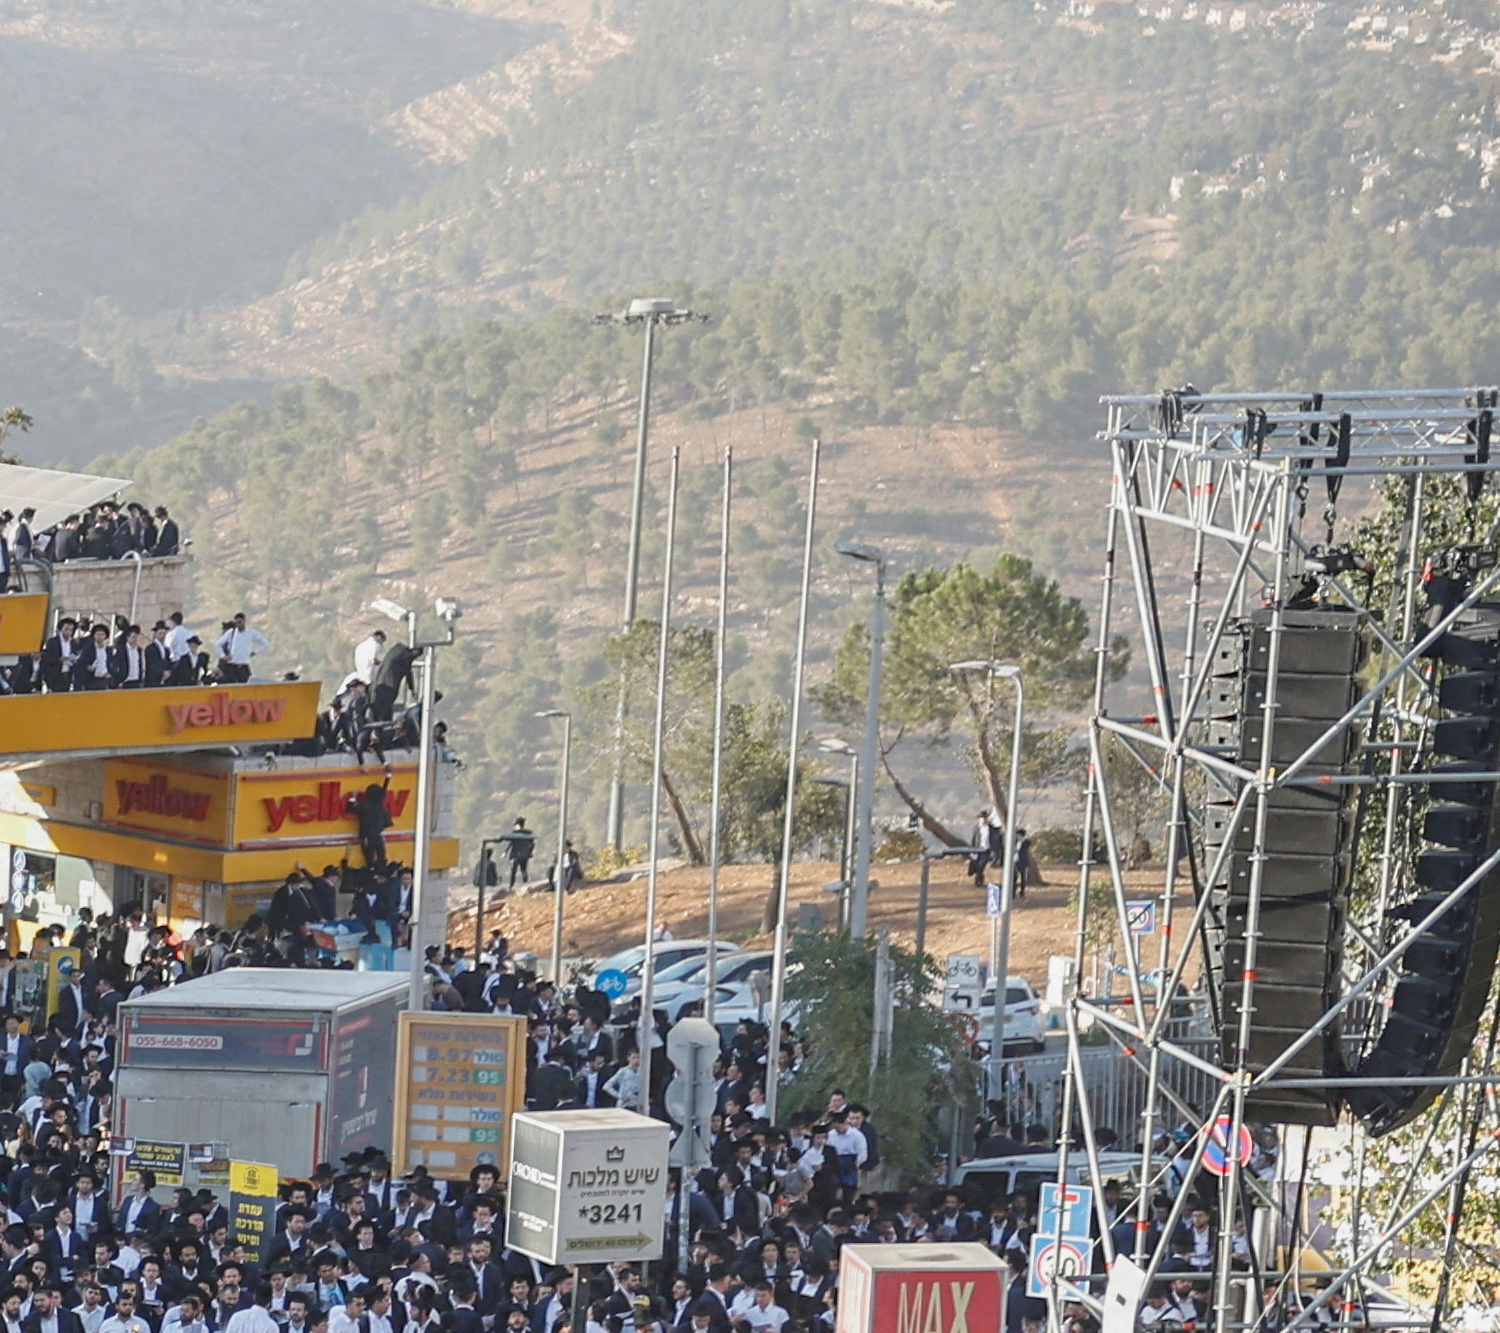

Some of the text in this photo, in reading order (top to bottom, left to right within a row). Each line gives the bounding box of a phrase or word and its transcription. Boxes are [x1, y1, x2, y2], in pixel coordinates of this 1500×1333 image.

[167, 691, 287, 734] yellow
[115, 774, 212, 823] yellow
[136, 1035, 218, 1048] 055-668-6050
[474, 1050, 503, 1063] סולר
[477, 1071, 499, 1084] 95
[471, 1107, 500, 1121] סולר
[475, 1130, 498, 1142] 95
[567, 1165, 660, 1190] שיש מלכות
